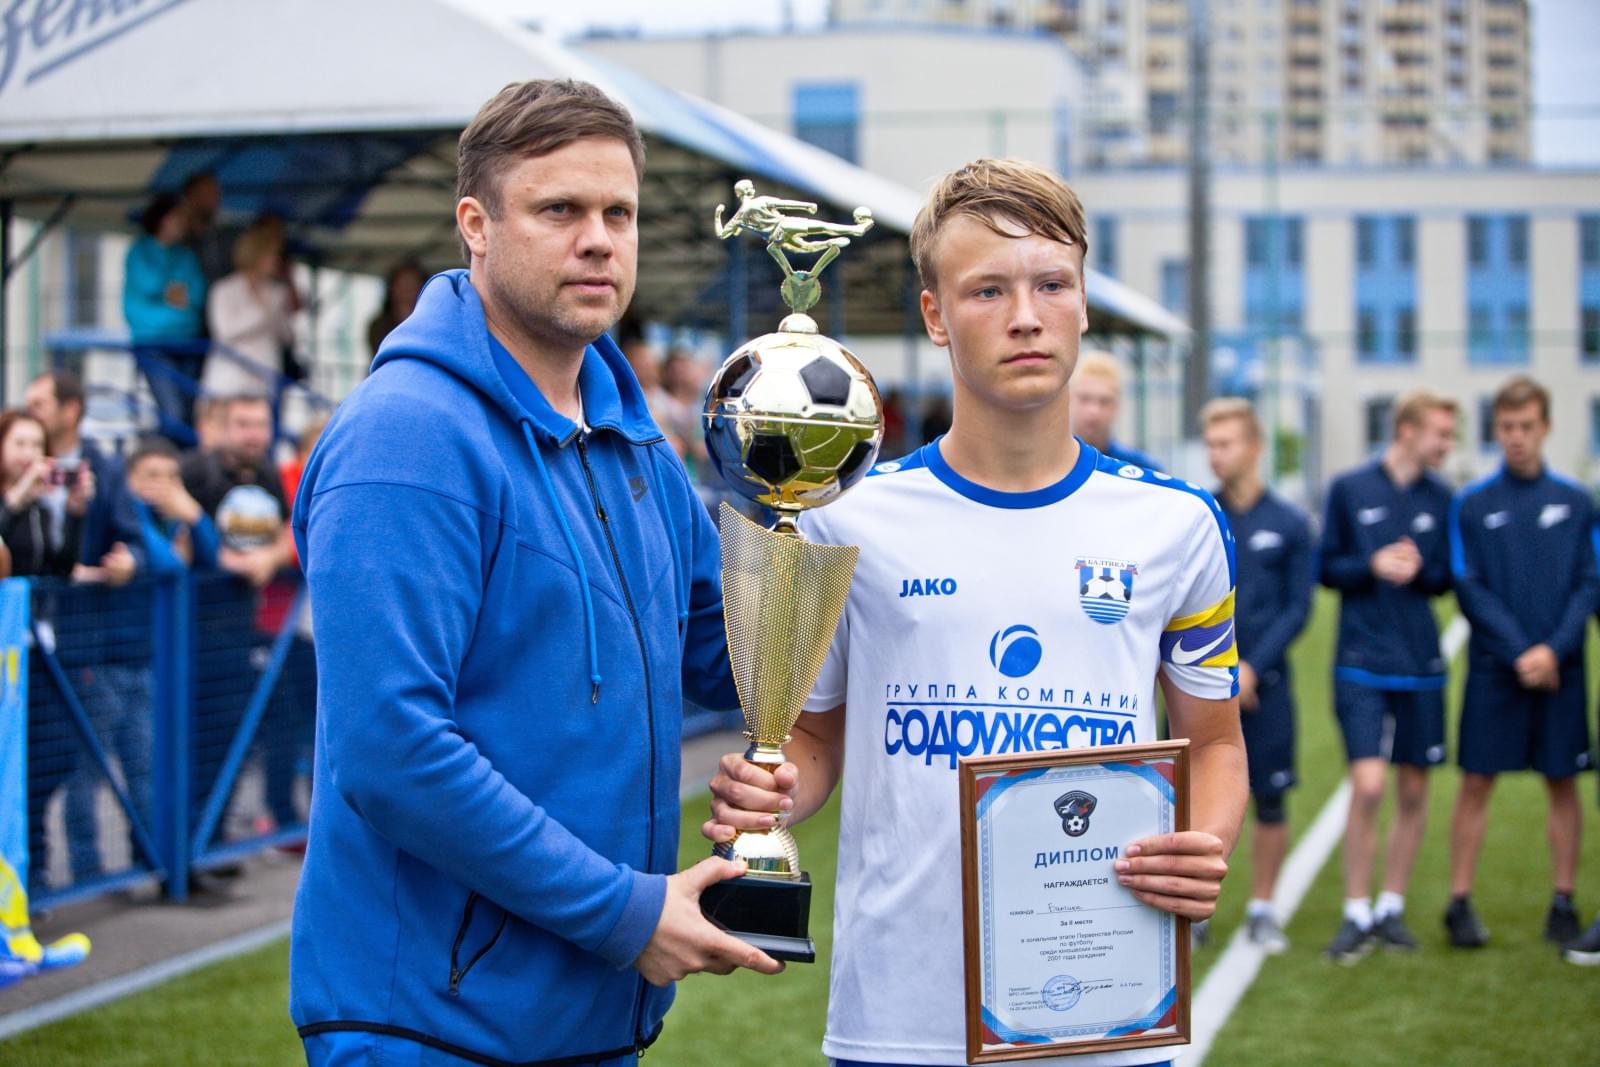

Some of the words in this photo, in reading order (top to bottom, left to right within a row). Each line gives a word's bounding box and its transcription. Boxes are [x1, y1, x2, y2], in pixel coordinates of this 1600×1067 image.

[899, 577, 957, 598] JAKO
[886, 684, 977, 699] ГРУППА
[998, 686, 1138, 711] КОМПАНИЙ
[1034, 846, 1119, 869] ДИПЛОМ
[1044, 877, 1109, 889] НАГРАЖДАЕТСЯ
